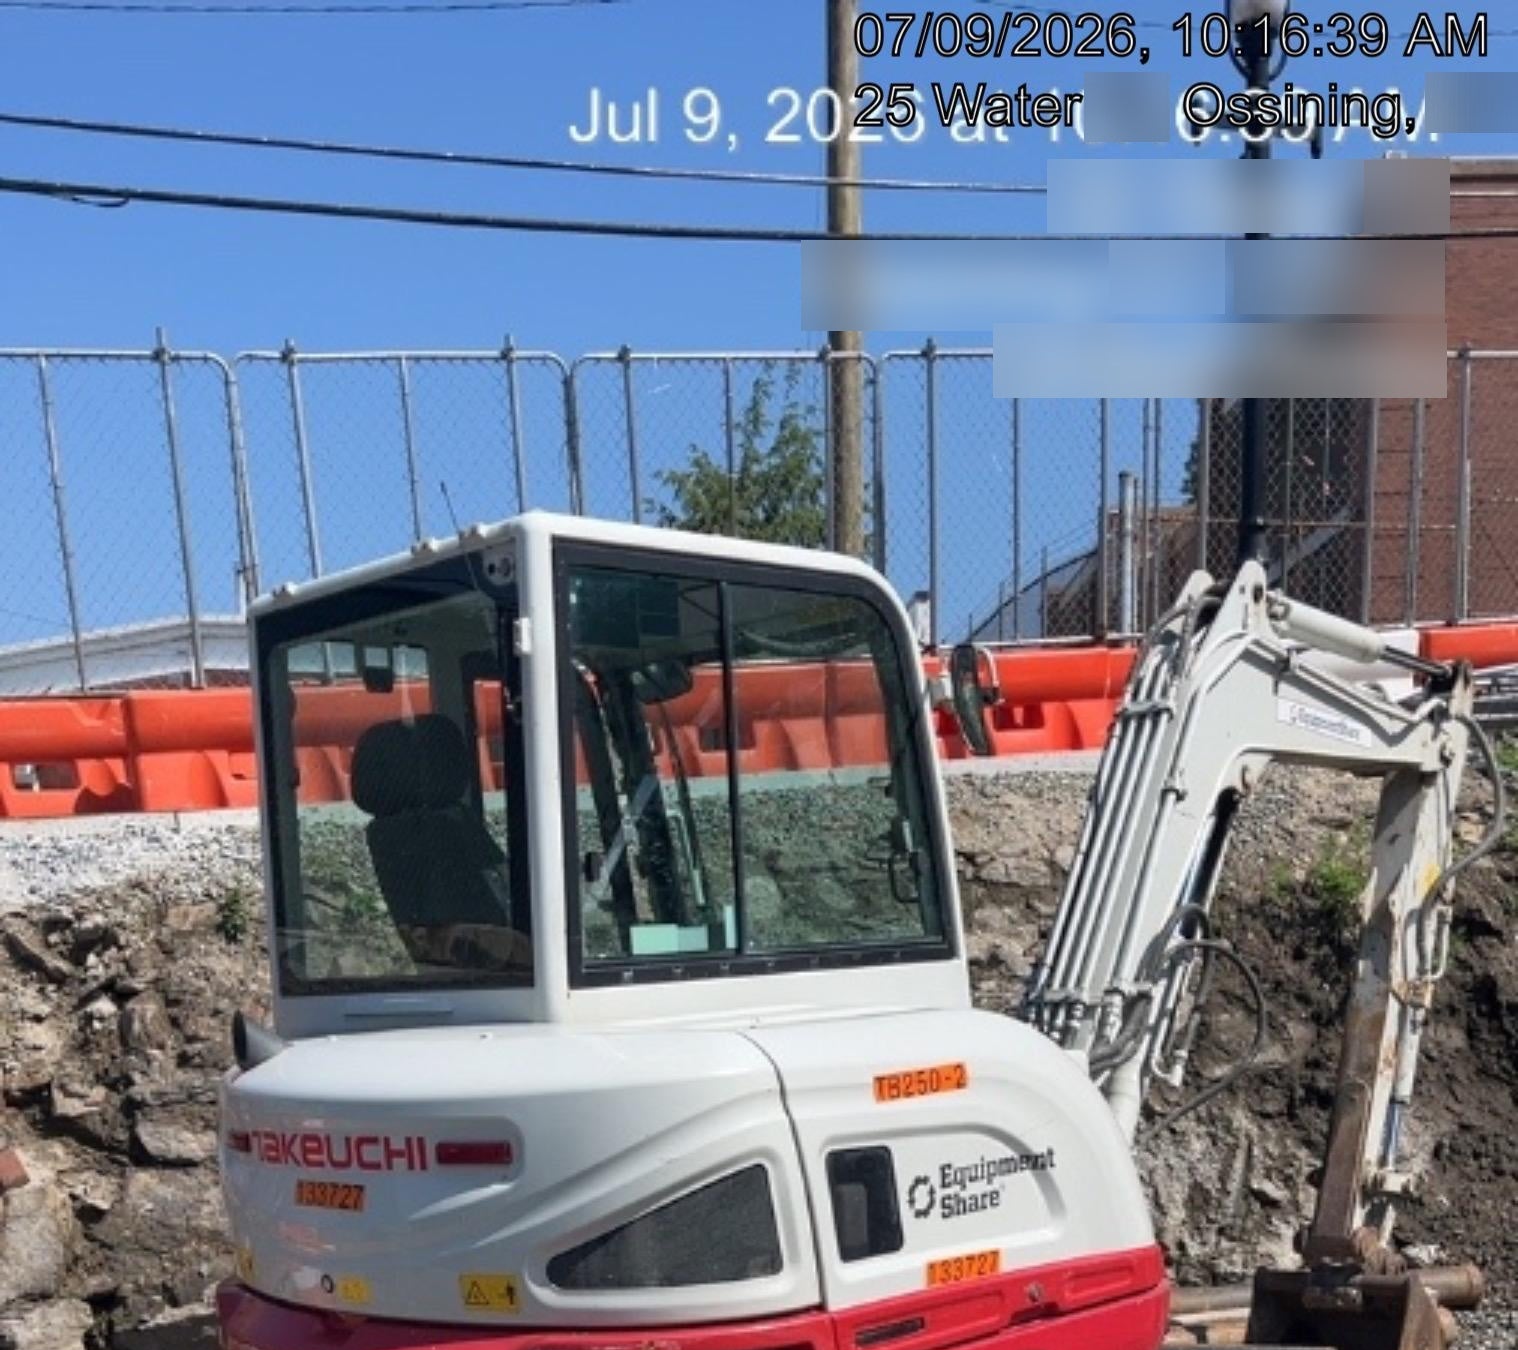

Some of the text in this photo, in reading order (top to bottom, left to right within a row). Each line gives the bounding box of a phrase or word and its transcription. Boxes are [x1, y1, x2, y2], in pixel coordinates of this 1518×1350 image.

[873, 1061, 968, 1102] TB250-2
[939, 1147, 1057, 1191] Equipment
[940, 1189, 1001, 1219] Share
